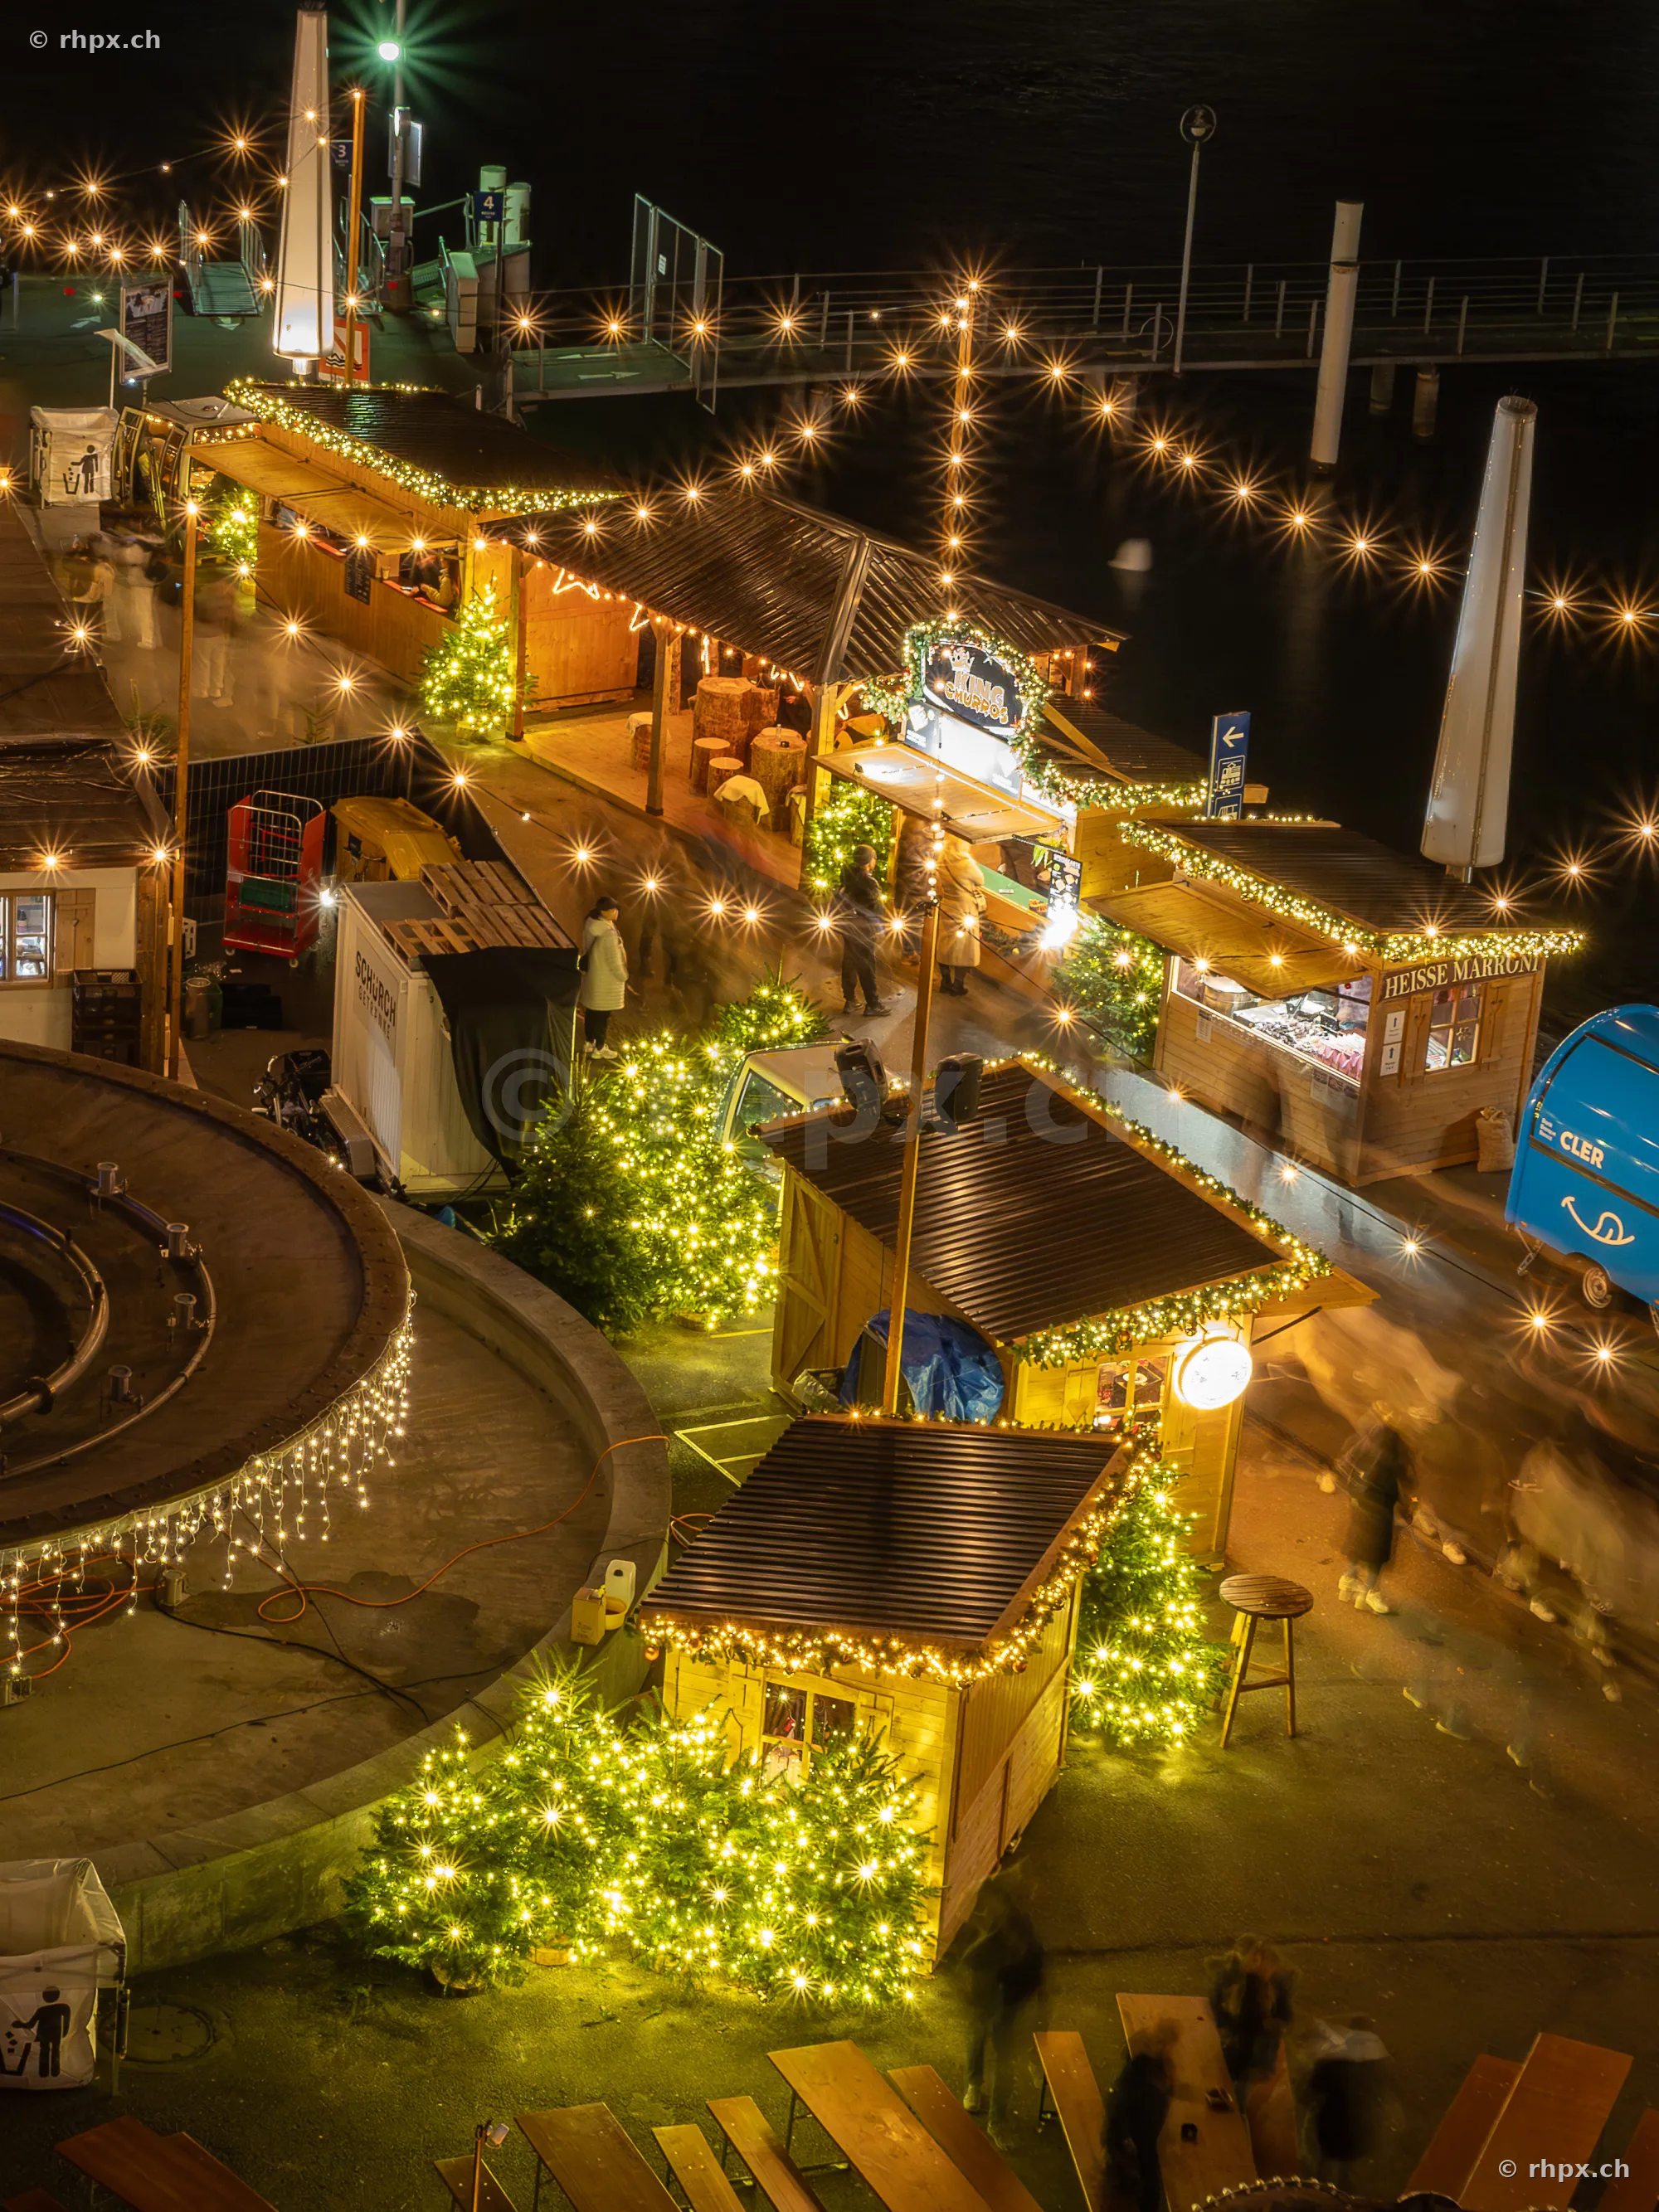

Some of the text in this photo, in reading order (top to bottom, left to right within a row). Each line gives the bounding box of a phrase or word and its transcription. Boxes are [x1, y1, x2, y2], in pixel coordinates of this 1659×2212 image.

[338, 144, 347, 158] 3
[484, 196, 494, 210] 4
[944, 681, 1009, 724] CHURROS
[953, 670, 1005, 707] KING
[1384, 963, 1448, 999] HEISSE
[1452, 954, 1540, 983] MARRONI
[355, 950, 397, 1028] SCHÜRCH
[1559, 1130, 1605, 1169] CLER
